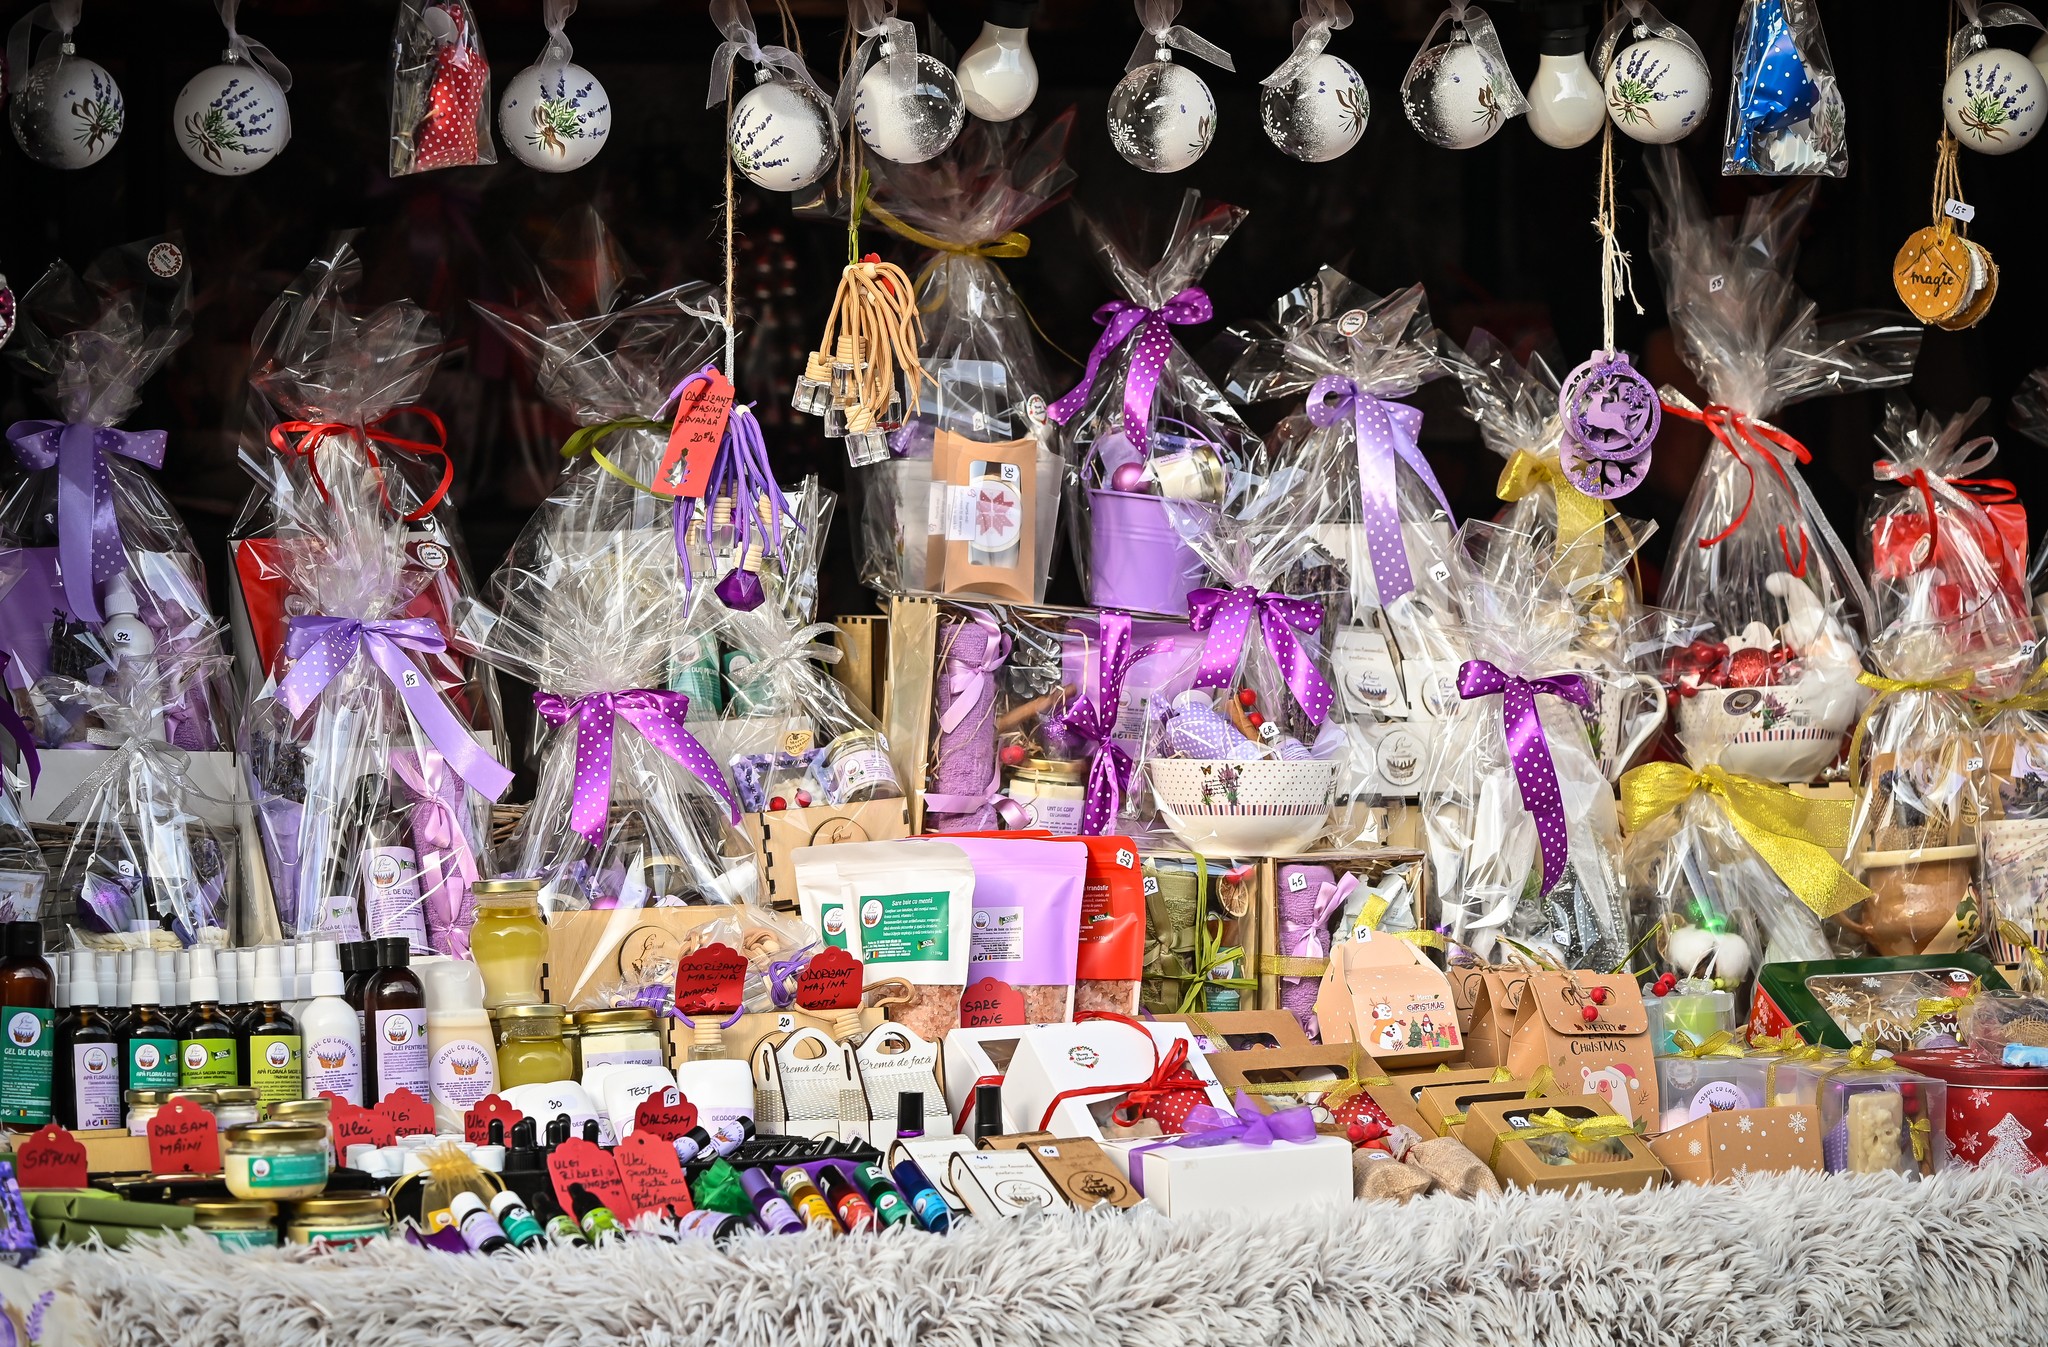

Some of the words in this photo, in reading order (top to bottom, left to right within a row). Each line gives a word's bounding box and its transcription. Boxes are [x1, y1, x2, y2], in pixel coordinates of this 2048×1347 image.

[1911, 271, 1954, 297] magic
[1004, 466, 1014, 479] 30
[117, 631, 131, 641] 92
[2021, 643, 2035, 655] 35
[1119, 850, 1132, 867] 25
[1144, 879, 1156, 893] 58
[1291, 875, 1304, 889] 45
[1357, 928, 1367, 940] 15
[963, 999, 1002, 1013] SARE
[1406, 1001, 1446, 1012] CHRISTMAS
[970, 1012, 1003, 1027] BAIE
[1584, 1023, 1618, 1032] MERRY
[17, 1048, 27, 1056] DE
[1570, 1039, 1627, 1056] CHRISTMAS
[811, 1062, 825, 1073] de
[896, 1056, 909, 1068] de
[627, 1085, 653, 1097] TEST
[548, 1099, 563, 1110] 30
[666, 1093, 678, 1105] 15
[154, 1121, 209, 1137] BALSAM
